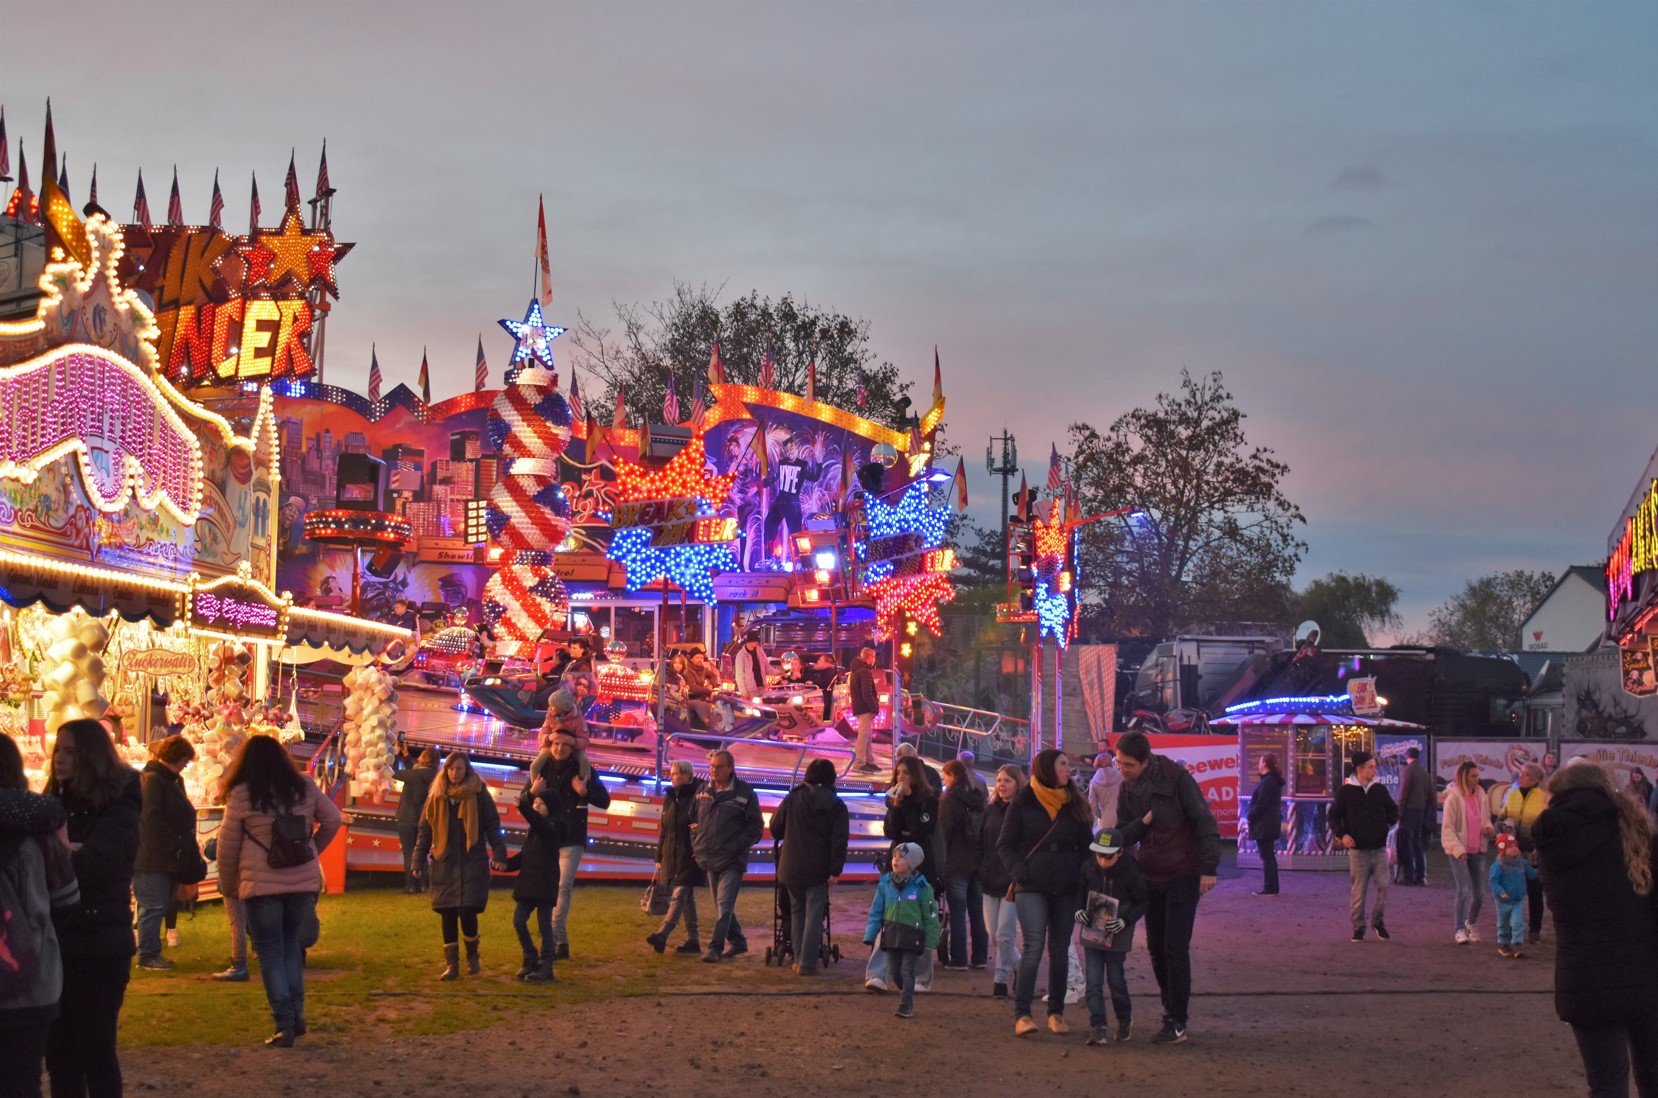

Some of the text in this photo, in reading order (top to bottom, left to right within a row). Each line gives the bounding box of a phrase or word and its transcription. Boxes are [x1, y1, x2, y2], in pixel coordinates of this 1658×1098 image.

[612, 498, 685, 529] BREAK
[650, 517, 738, 547] DANCER
[126, 650, 195, 669] Zuckerwatte
